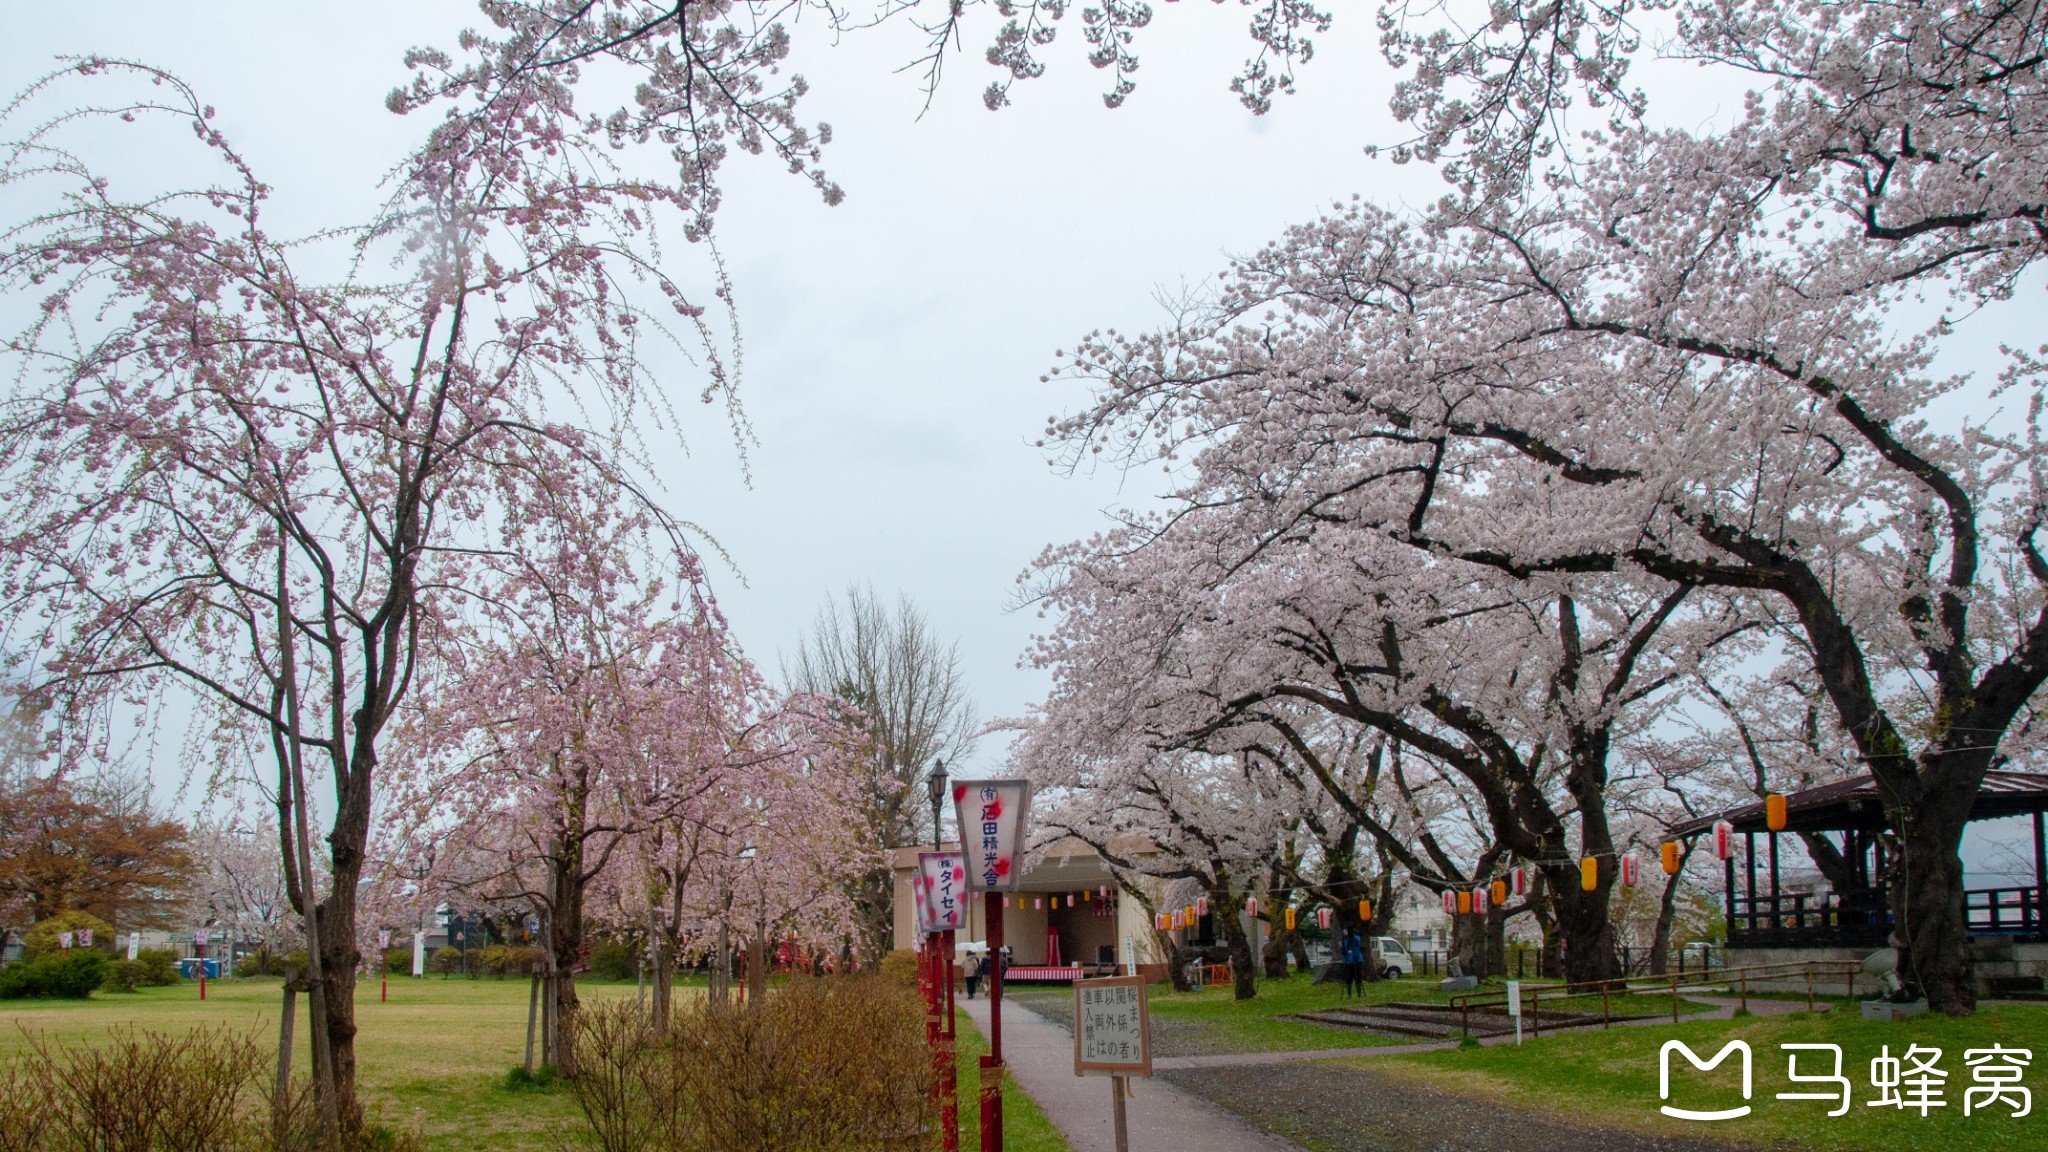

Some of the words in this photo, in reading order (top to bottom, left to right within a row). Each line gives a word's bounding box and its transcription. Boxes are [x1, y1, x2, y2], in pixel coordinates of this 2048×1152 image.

[1083, 989, 1096, 1058] 進入禁止
[1093, 989, 1107, 1056] 車両は
[1104, 988, 1118, 1056] 以外の
[1115, 987, 1130, 1060] 関係者
[1127, 986, 1141, 1060] 桜まつり
